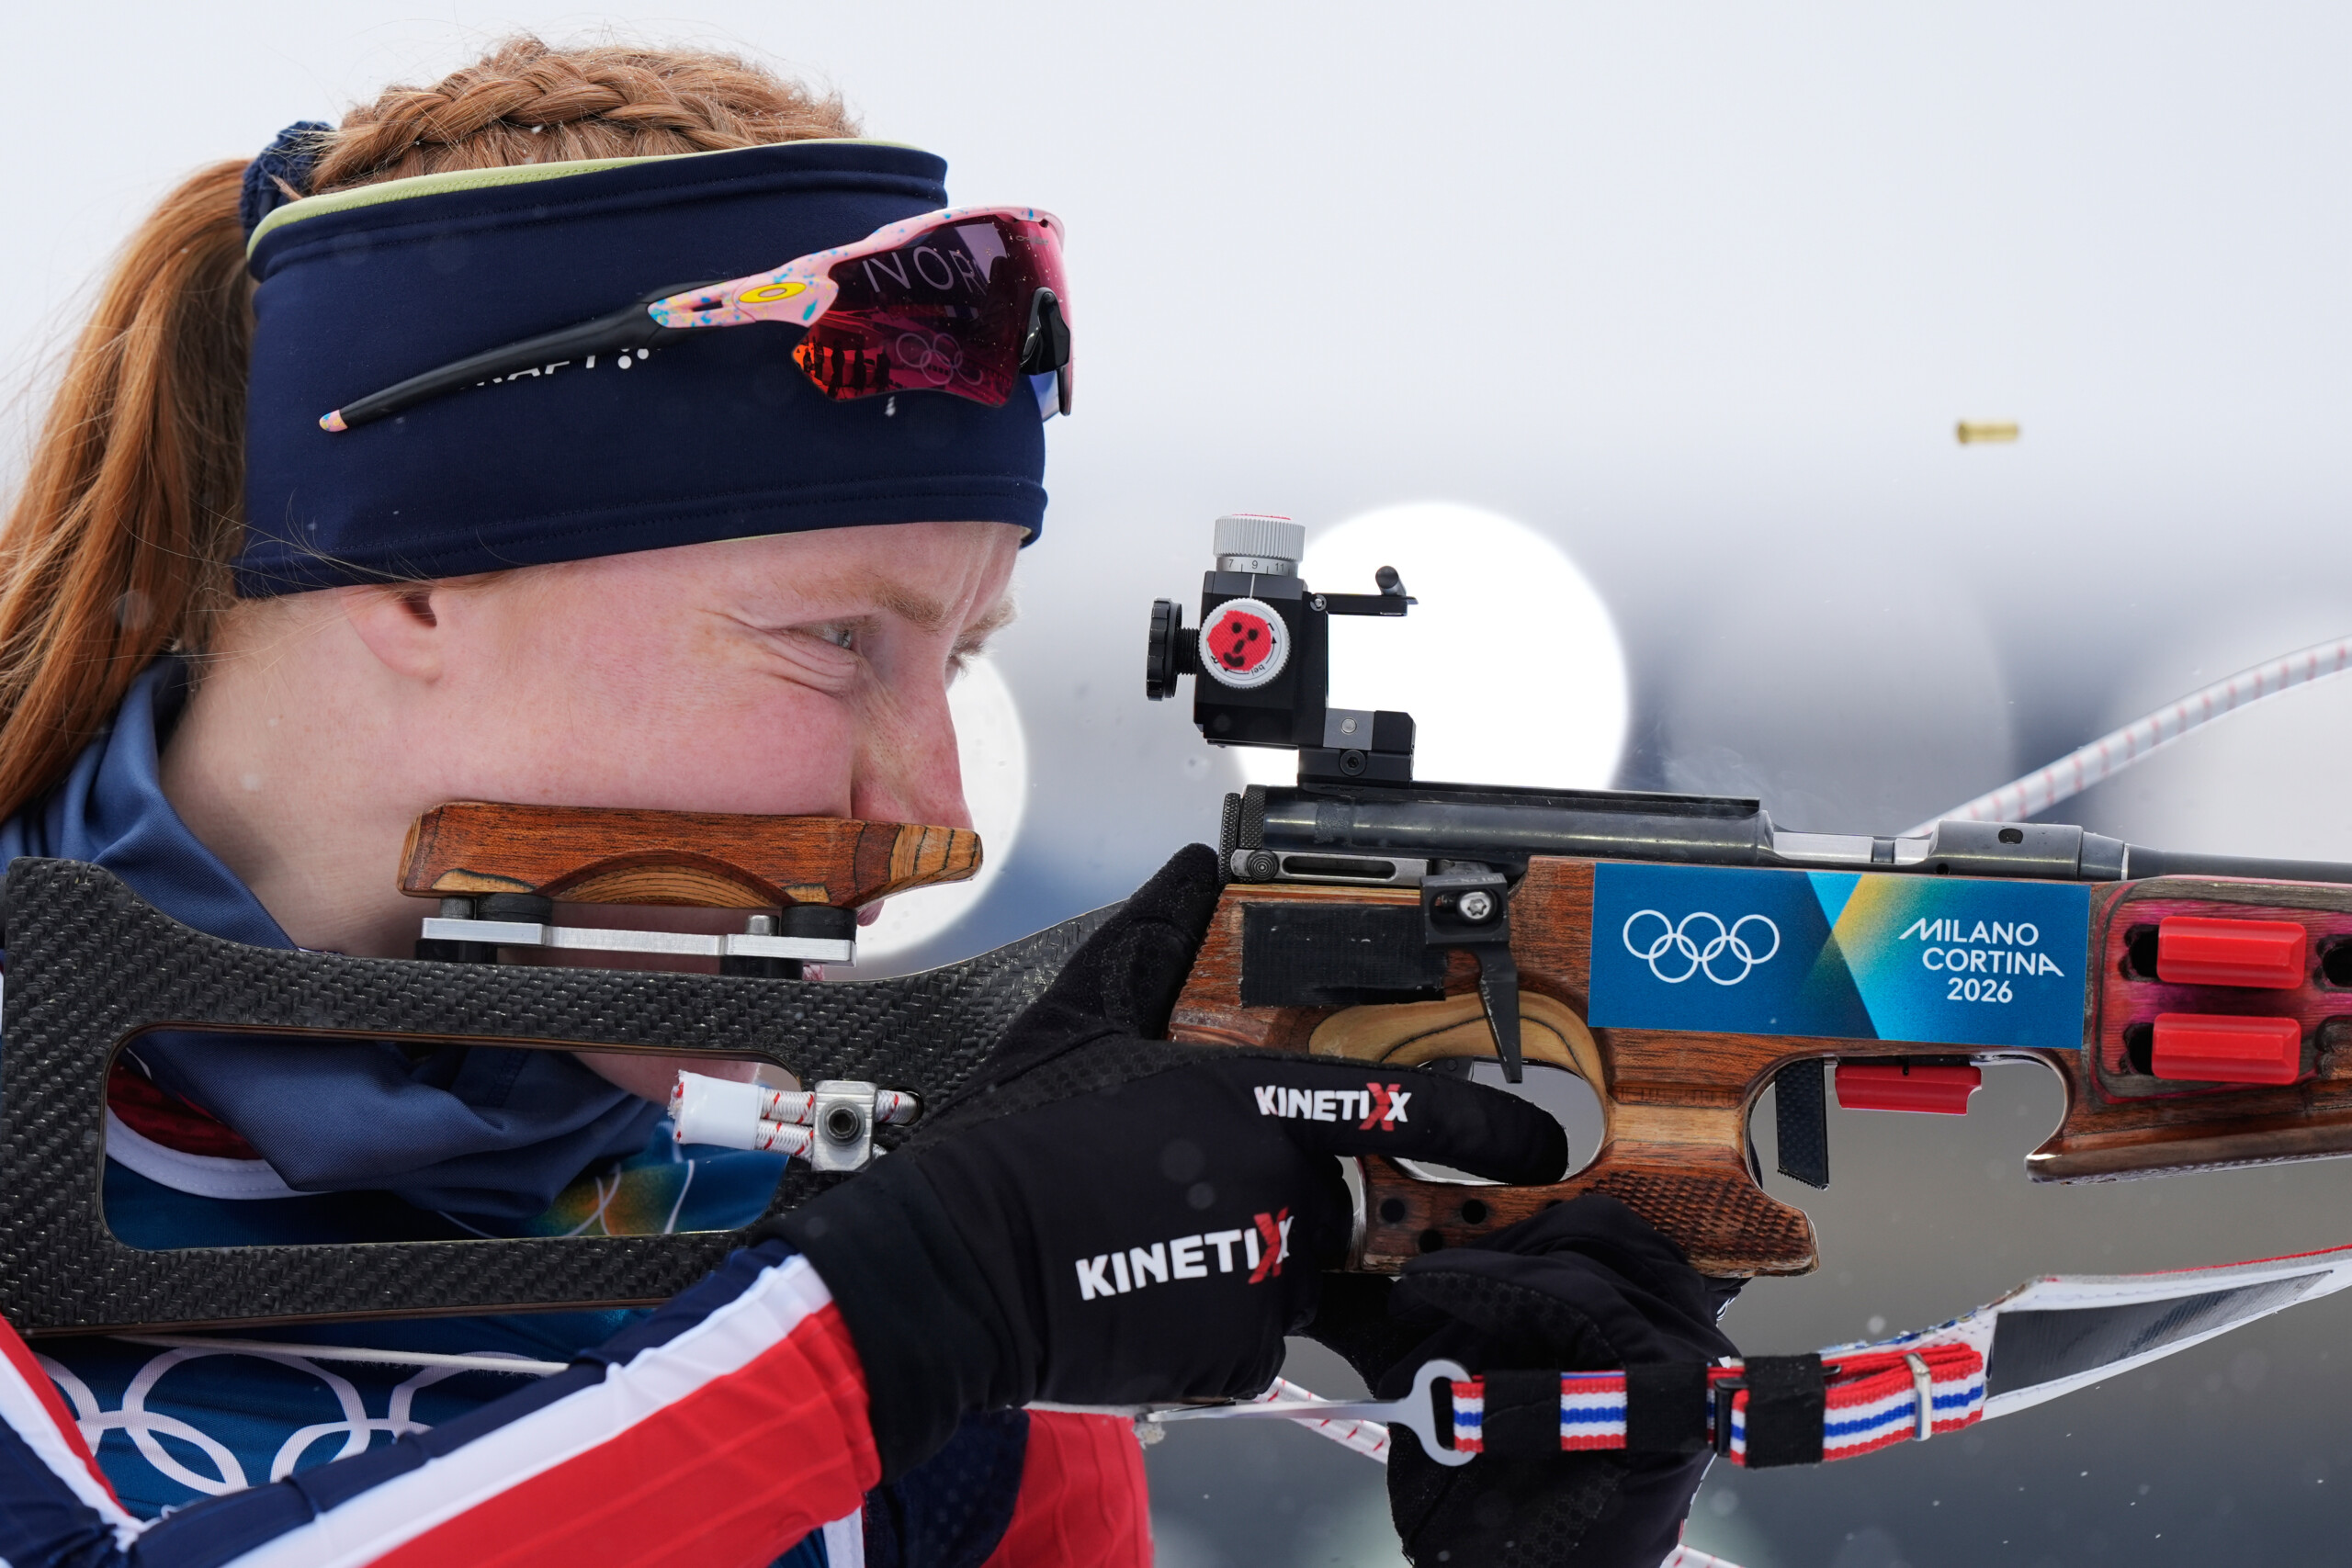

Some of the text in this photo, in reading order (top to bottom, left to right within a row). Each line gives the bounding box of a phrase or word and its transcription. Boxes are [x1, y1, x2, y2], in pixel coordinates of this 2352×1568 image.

[1228, 558, 1284, 572] 7 9 11
[1898, 917, 2039, 947] MILANO
[1922, 947, 2064, 977] CORTINA
[1946, 976, 2013, 1003] 2026
[1253, 1082, 1412, 1132] KINETIXX
